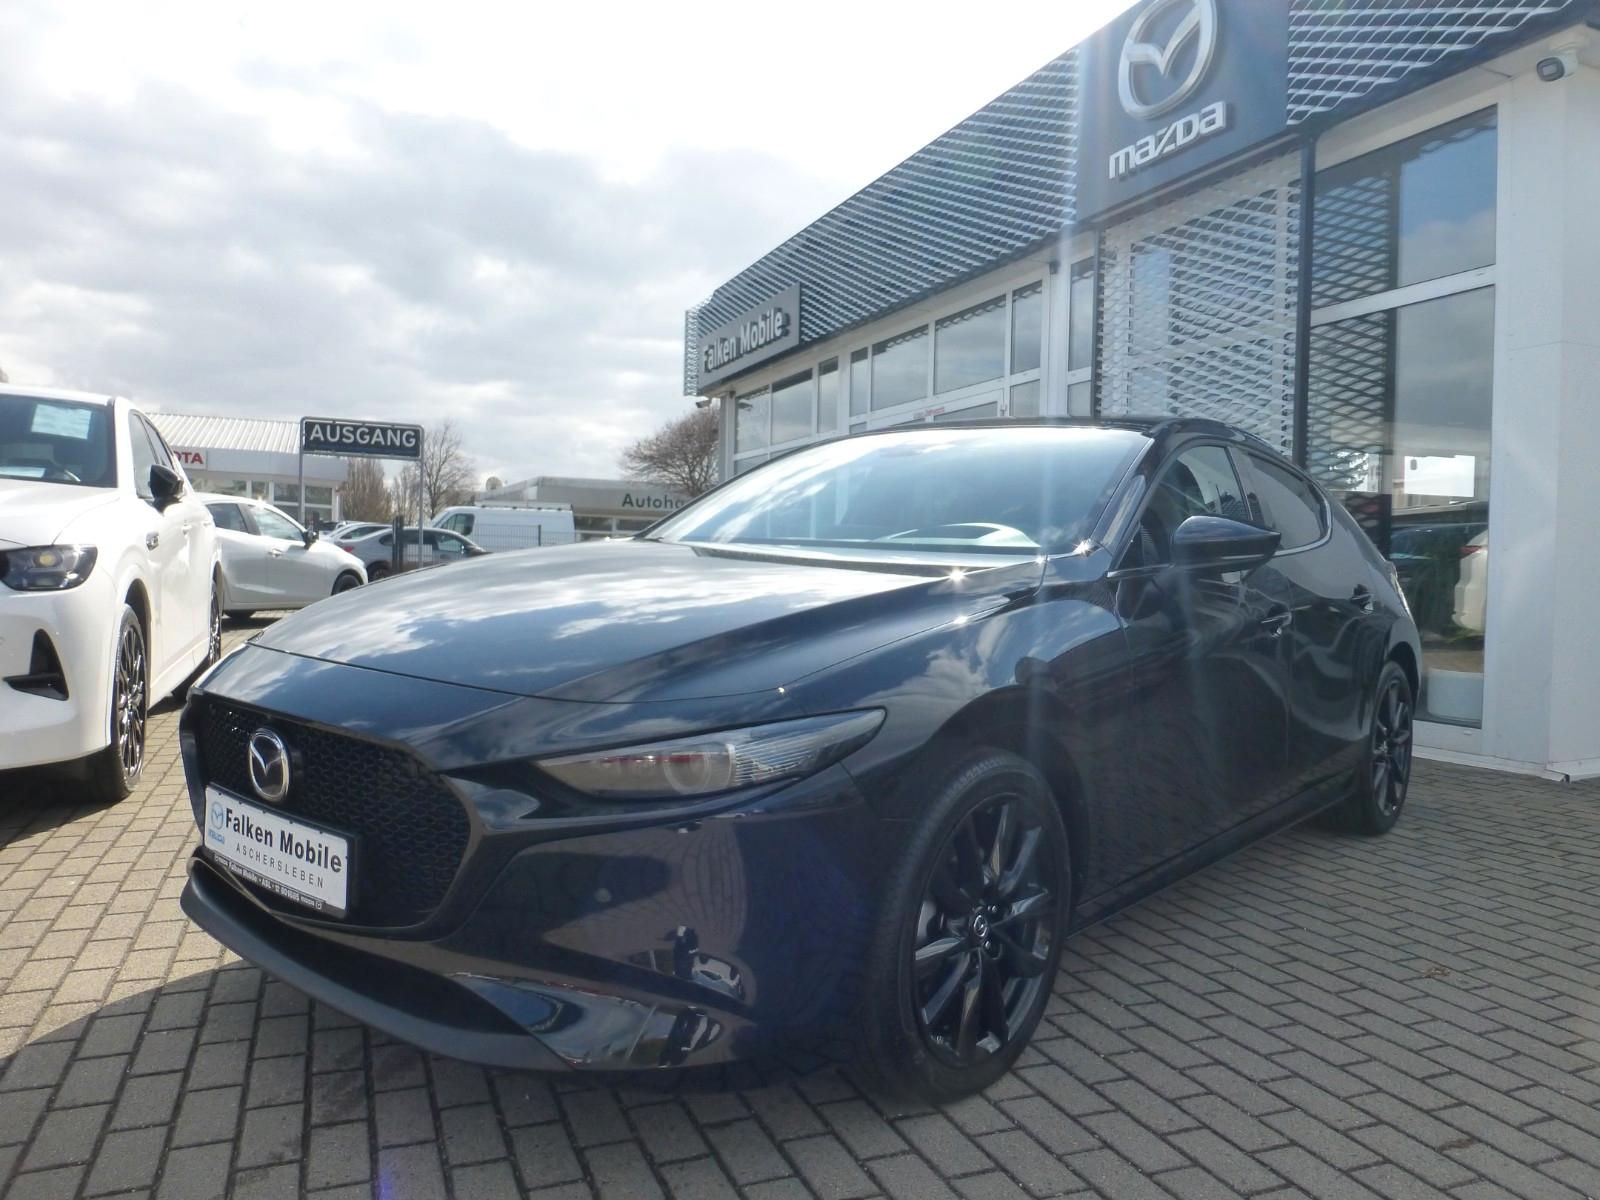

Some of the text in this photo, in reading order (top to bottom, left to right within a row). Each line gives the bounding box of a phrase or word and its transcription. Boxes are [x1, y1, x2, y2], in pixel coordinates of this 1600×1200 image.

[1108, 101, 1226, 180] mazda
[703, 308, 783, 371] Falken Mobile
[310, 423, 416, 448] AUSGANG
[225, 807, 342, 873] Falken Mobile
[236, 843, 323, 888] ASCHERSLEBEN
